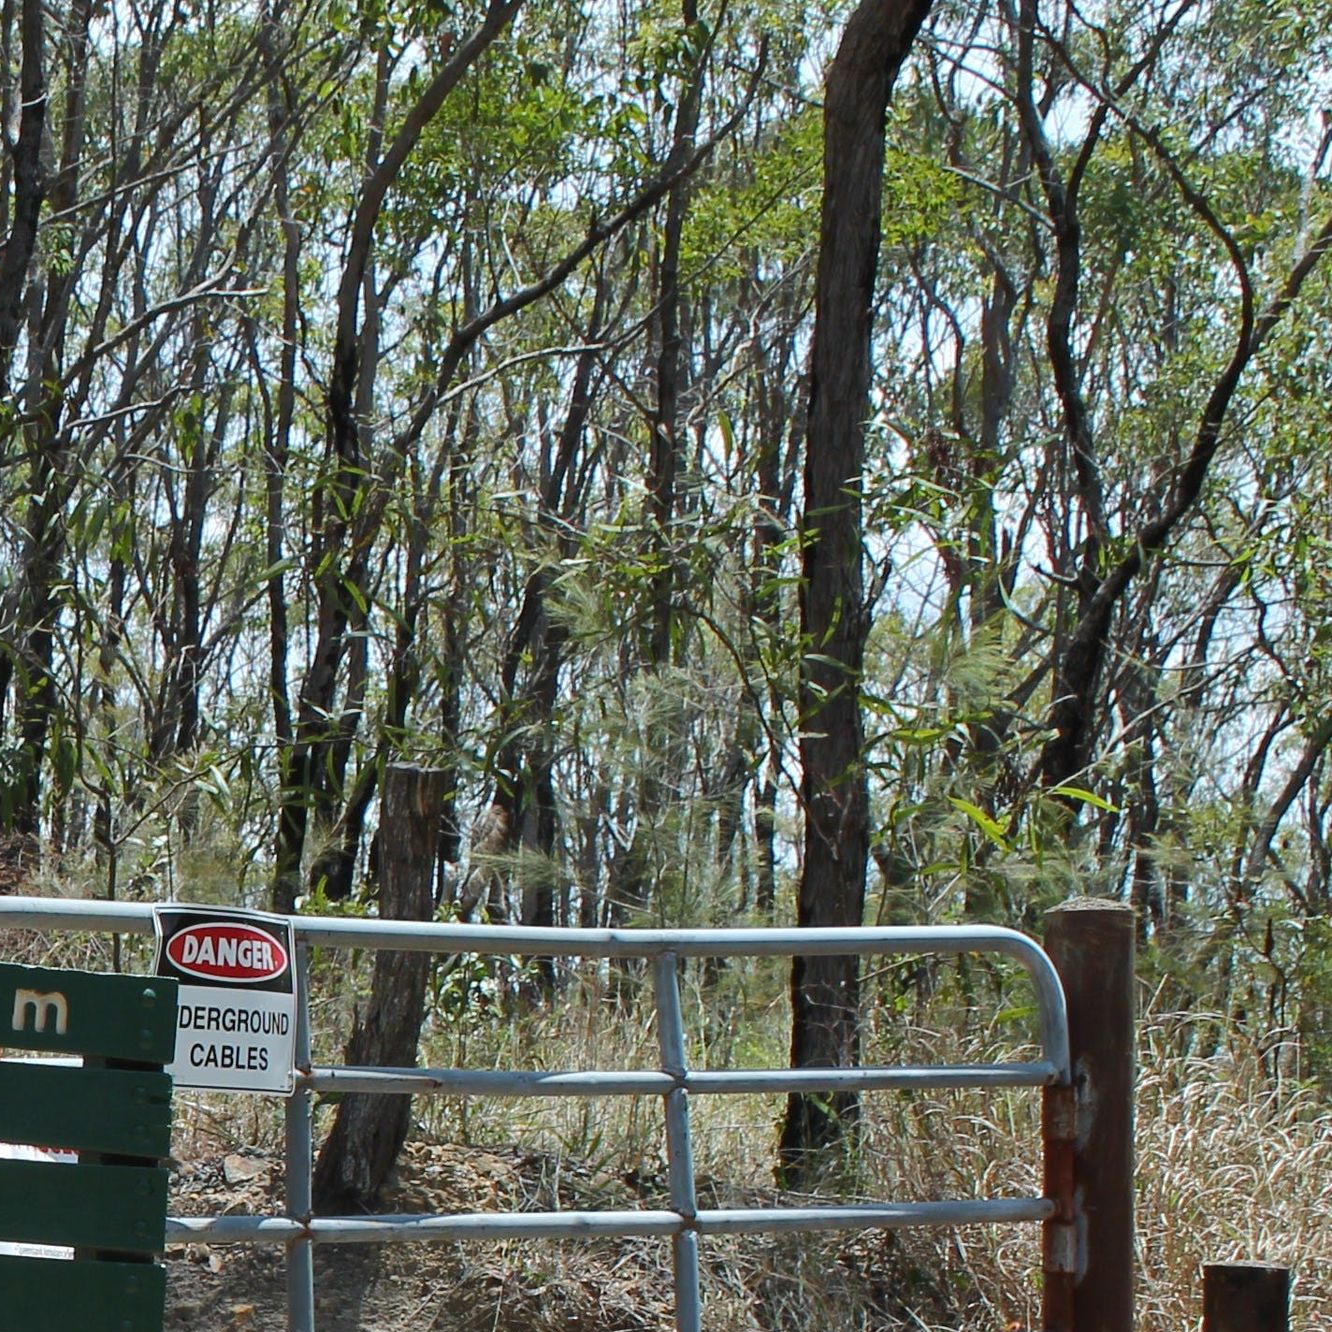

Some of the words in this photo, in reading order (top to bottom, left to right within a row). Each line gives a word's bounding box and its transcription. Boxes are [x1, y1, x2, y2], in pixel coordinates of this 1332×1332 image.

[181, 934, 275, 971] DANGER
[11, 988, 69, 1034] m
[179, 1005, 289, 1036] DERGROUND
[190, 1043, 269, 1071] CABLES
